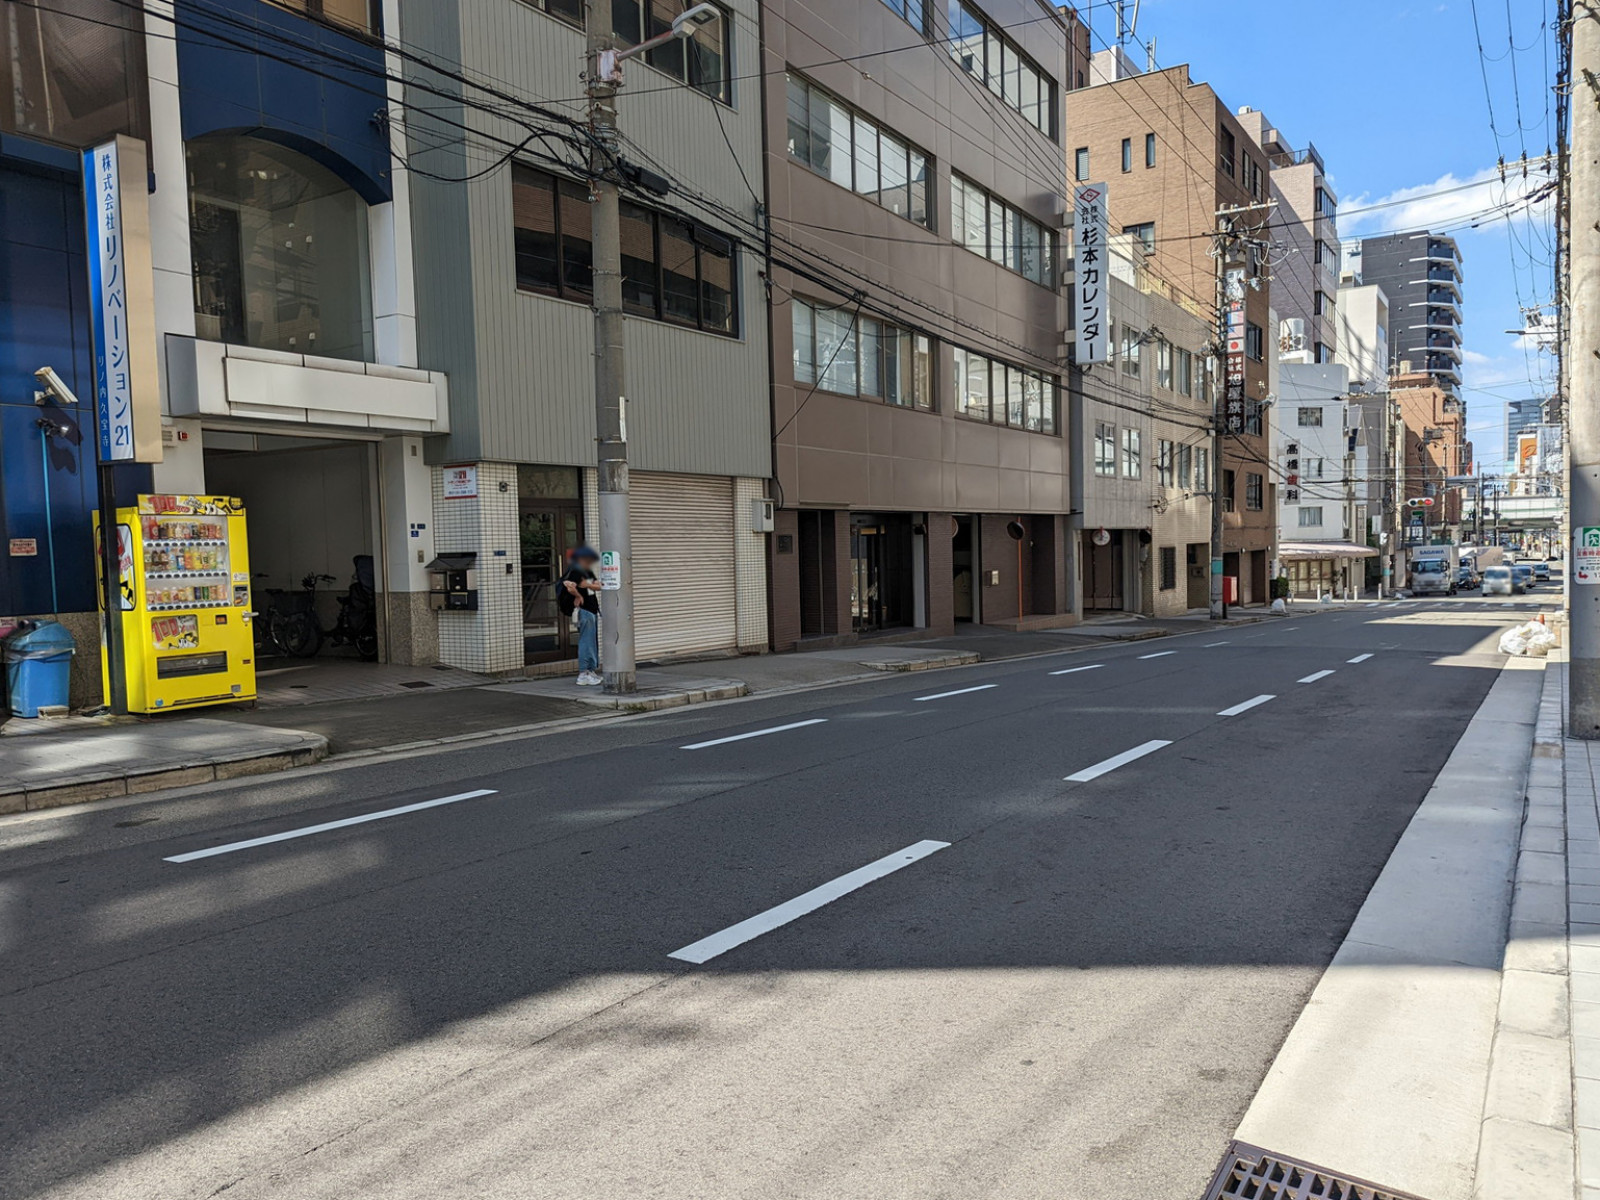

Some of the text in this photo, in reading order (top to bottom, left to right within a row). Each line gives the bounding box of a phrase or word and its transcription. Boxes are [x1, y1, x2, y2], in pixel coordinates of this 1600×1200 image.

[1081, 227, 1100, 360] 杉本カレンダー
